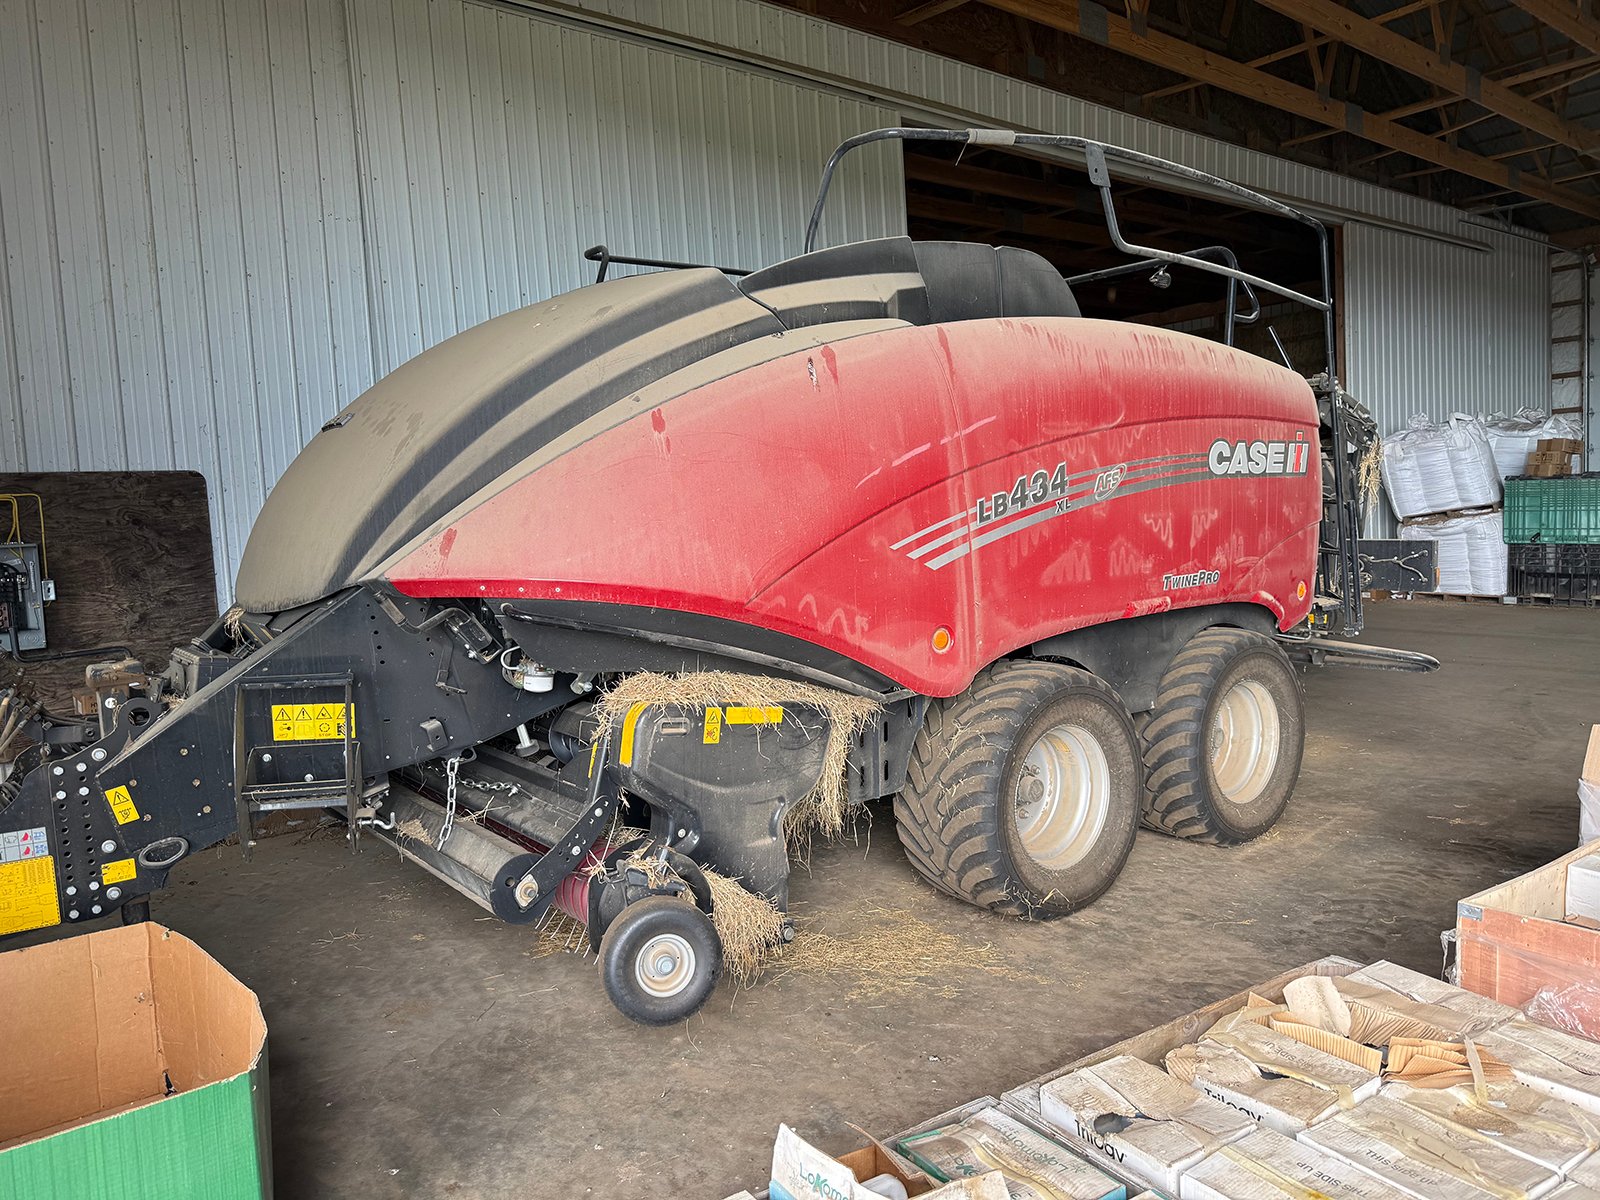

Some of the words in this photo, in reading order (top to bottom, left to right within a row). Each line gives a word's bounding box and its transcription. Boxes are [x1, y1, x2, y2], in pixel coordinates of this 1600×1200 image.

[1208, 440, 1286, 476] CASE
[1094, 467, 1122, 494] AFS
[976, 461, 1068, 526] LB434
[1055, 497, 1072, 514] XL
[1365, 1149, 1392, 1166] THIS
[1296, 1161, 1314, 1173] UP
[1313, 1170, 1342, 1187] SIDE
[1341, 1183, 1372, 1198] THIS
